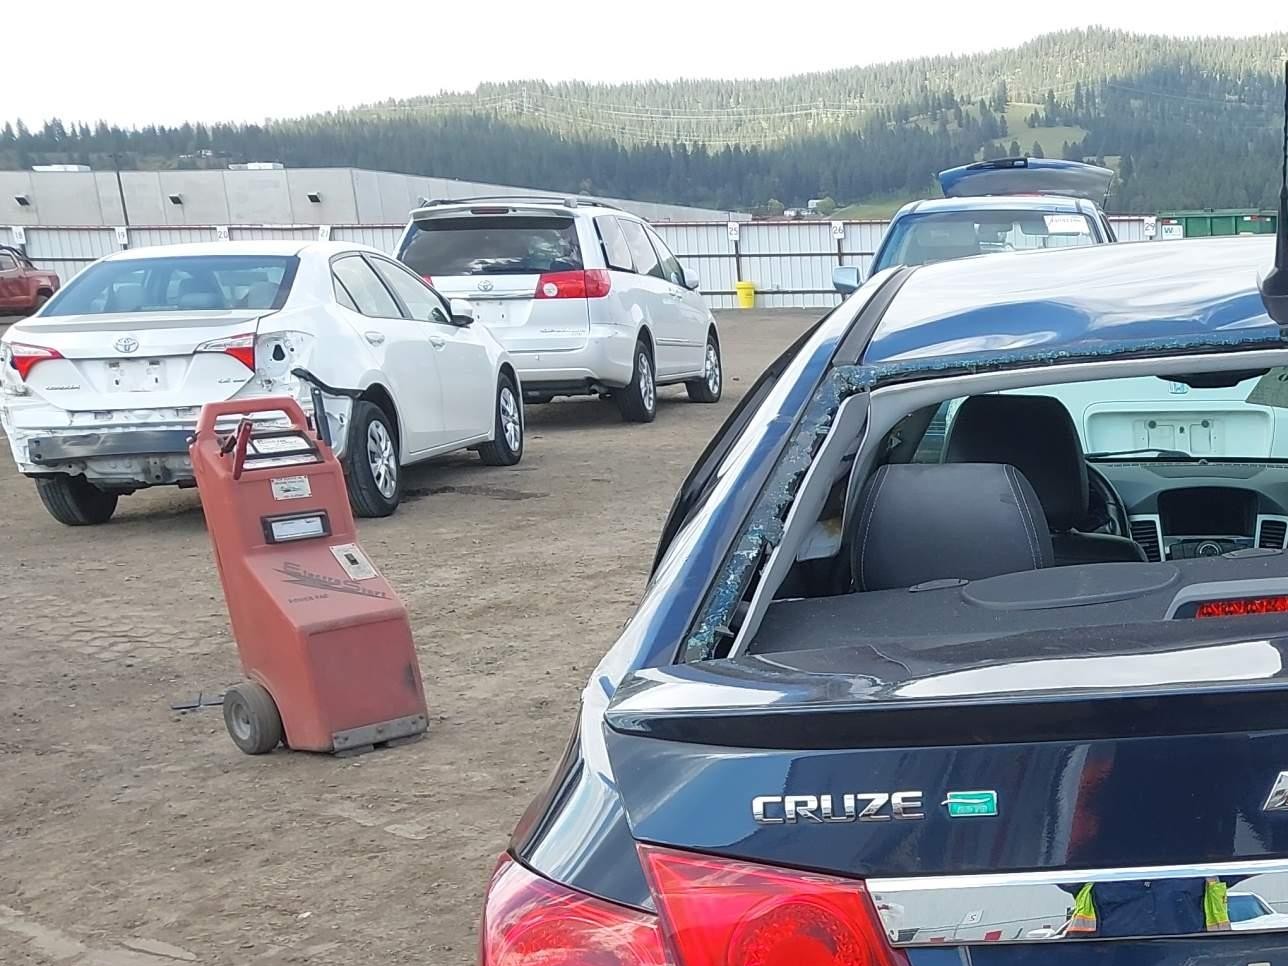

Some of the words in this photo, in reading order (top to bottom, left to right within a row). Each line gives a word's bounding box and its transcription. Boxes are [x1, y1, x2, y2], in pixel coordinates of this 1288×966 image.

[728, 226, 738, 235] 25
[832, 225, 843, 234] 26
[1144, 222, 1155, 231] 29
[218, 230, 228, 239] 20
[320, 229, 329, 238] 21
[752, 791, 925, 824] CRUZE
